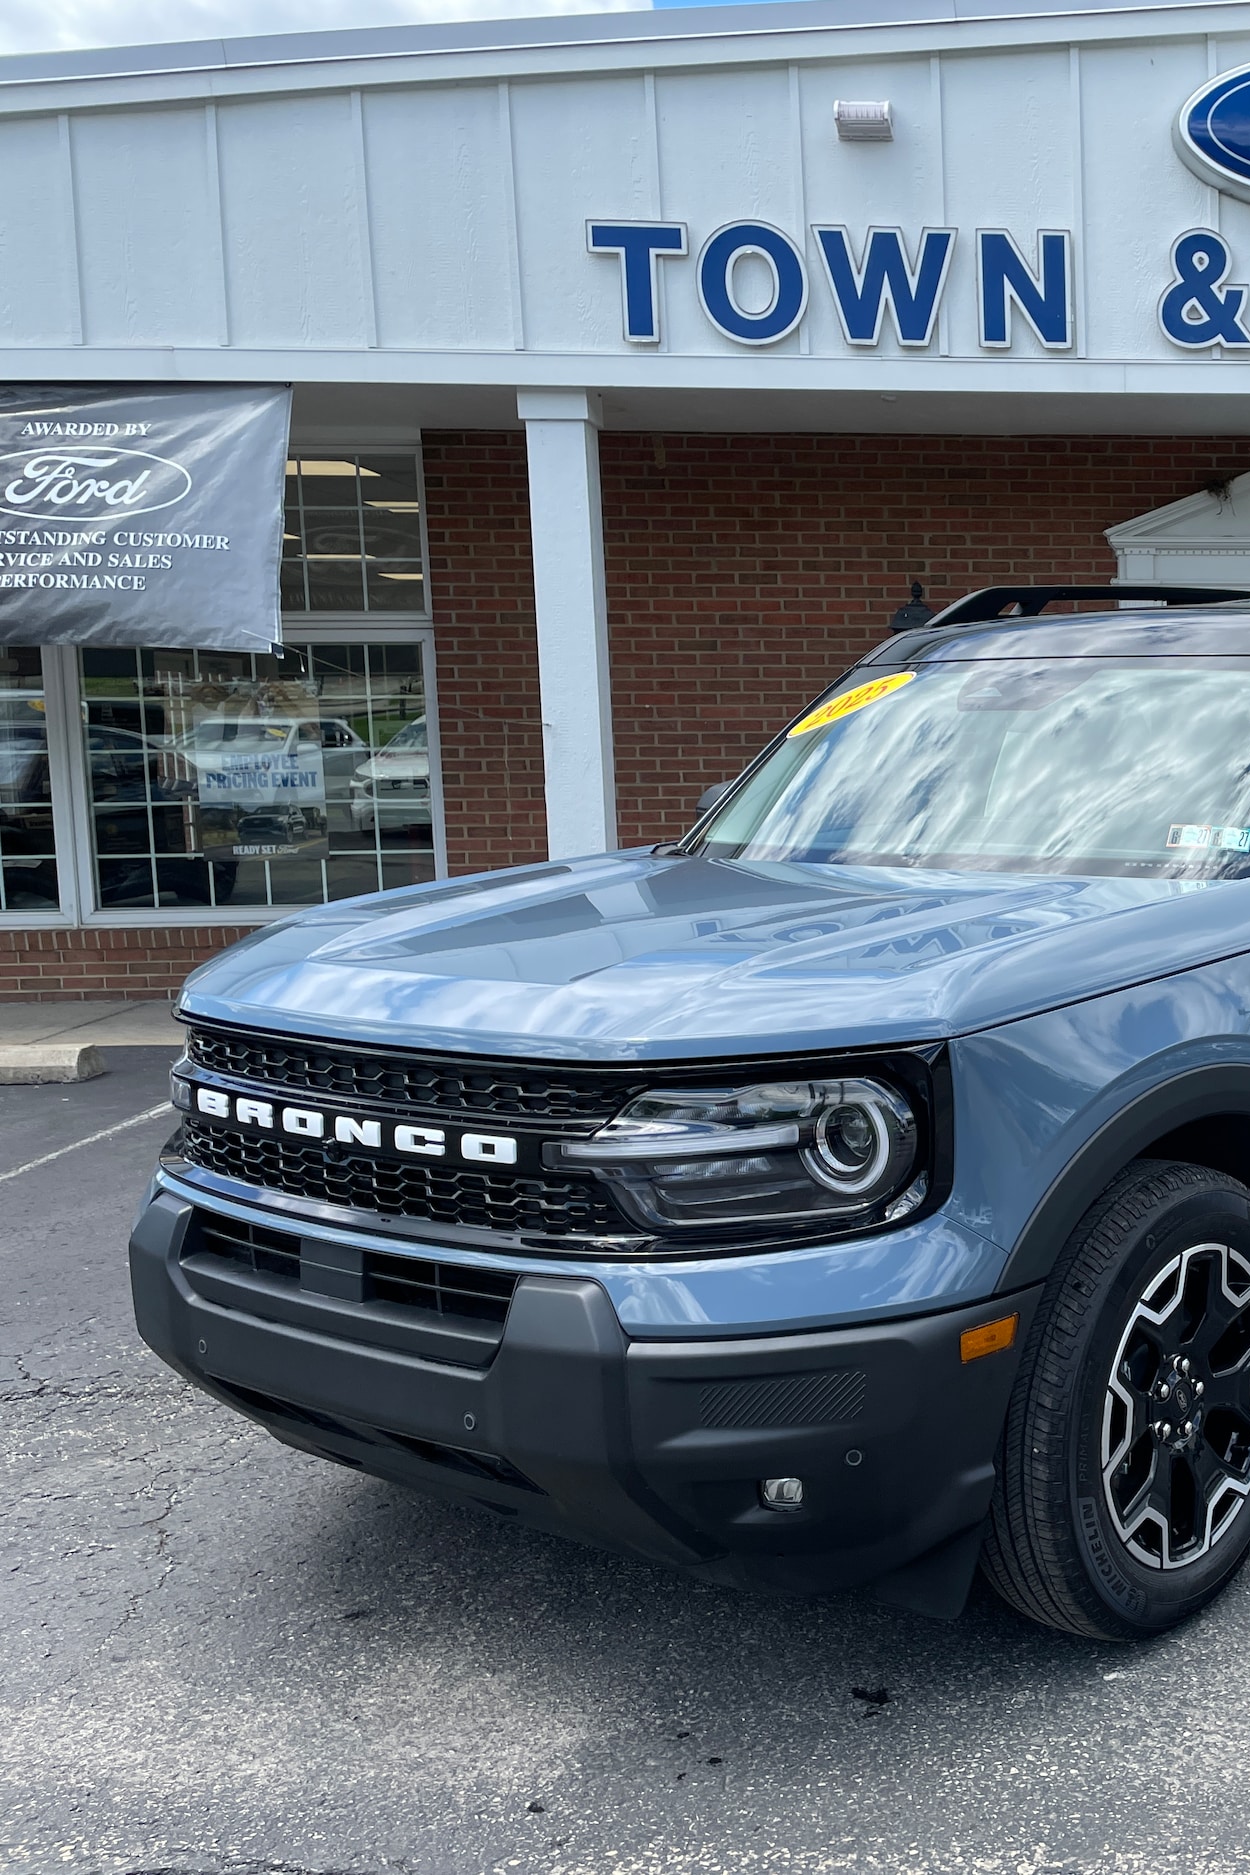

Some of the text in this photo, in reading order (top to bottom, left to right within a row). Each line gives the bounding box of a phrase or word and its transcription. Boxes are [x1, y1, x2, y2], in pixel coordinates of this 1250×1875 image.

[586, 219, 1075, 350] TOWN
[21, 421, 153, 437] AWARDED BY
[4, 455, 151, 505] Ford
[113, 531, 231, 550] CUSTOMER
[58, 552, 103, 567] AND
[108, 554, 173, 569] SALES
[0, 573, 147, 591] ERFORMANCE
[803, 677, 897, 729] 2025
[221, 753, 299, 772] EMPLOYEE
[205, 771, 318, 789] PRICING EVENT
[1238, 831, 1250, 847] 27
[232, 844, 260, 855] READY
[261, 844, 277, 855] SET
[196, 1087, 518, 1165] BRONCO
[1082, 1502, 1127, 1597] MICHELIN
